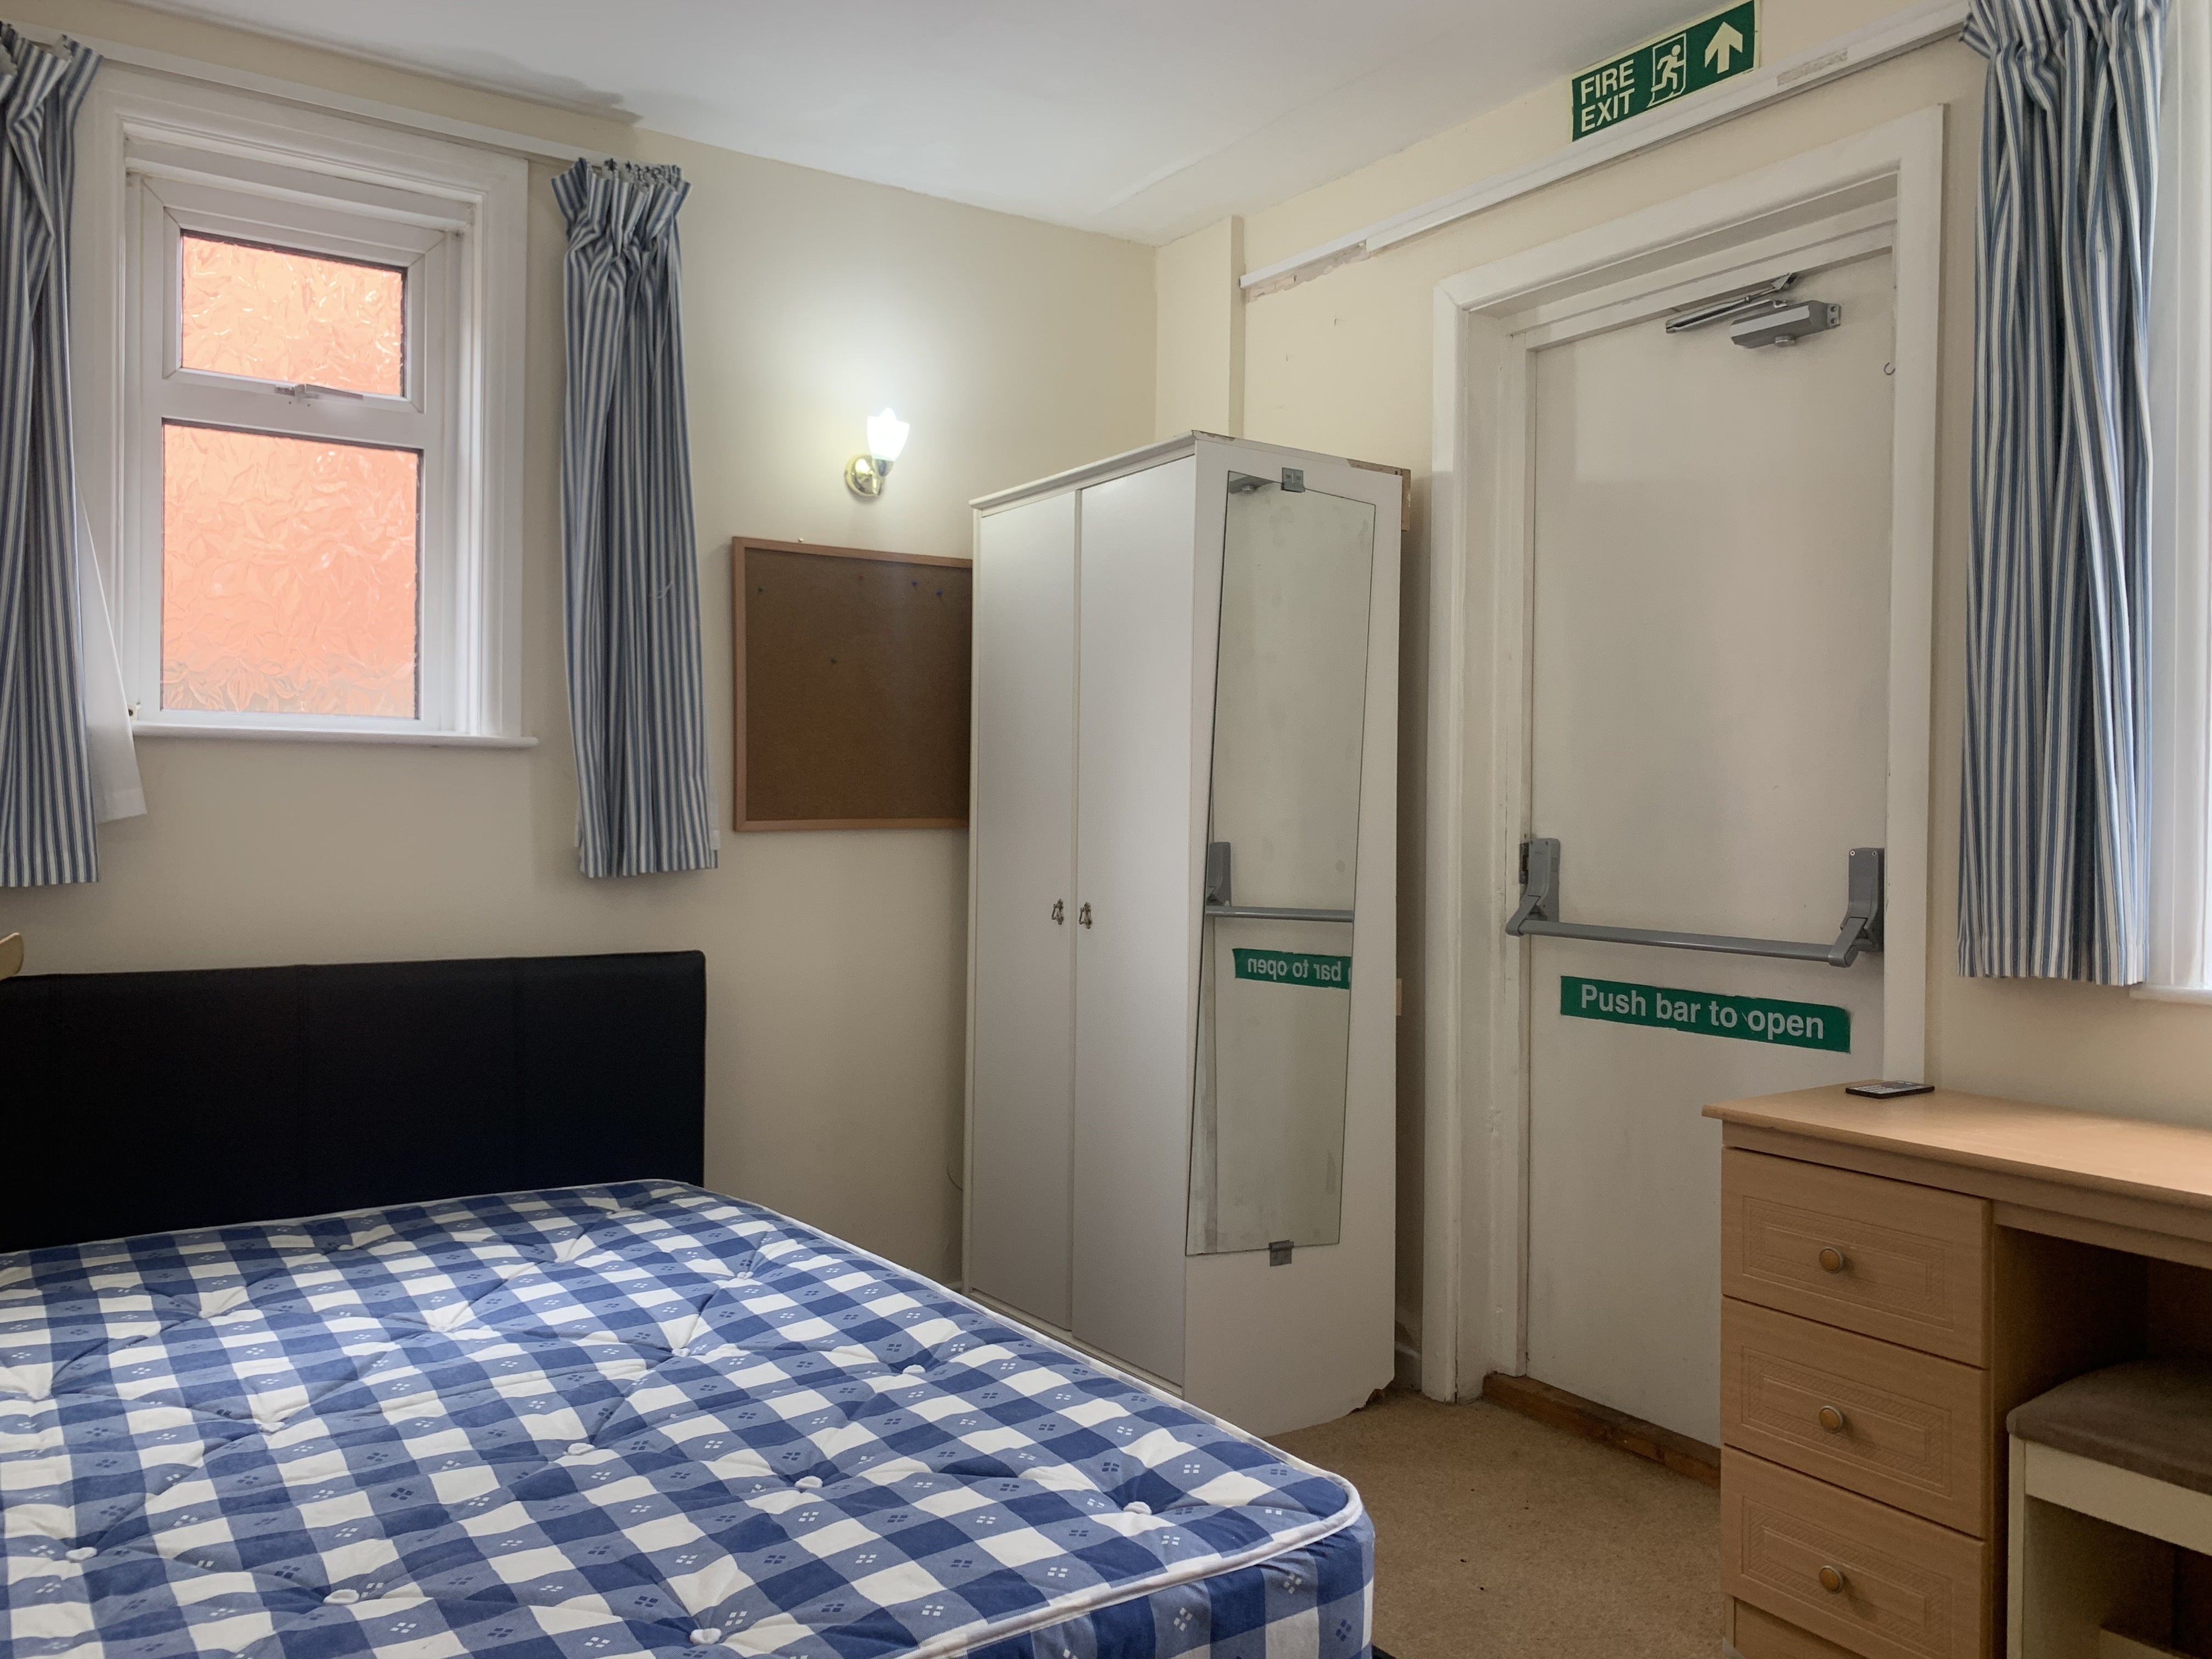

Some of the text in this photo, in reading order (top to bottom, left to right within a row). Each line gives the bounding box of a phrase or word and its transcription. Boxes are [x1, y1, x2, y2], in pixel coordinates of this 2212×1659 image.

[1581, 59, 1634, 104] FIRE
[1581, 88, 1635, 132] EXIT
[1581, 984, 1824, 1040] Push bar to open
